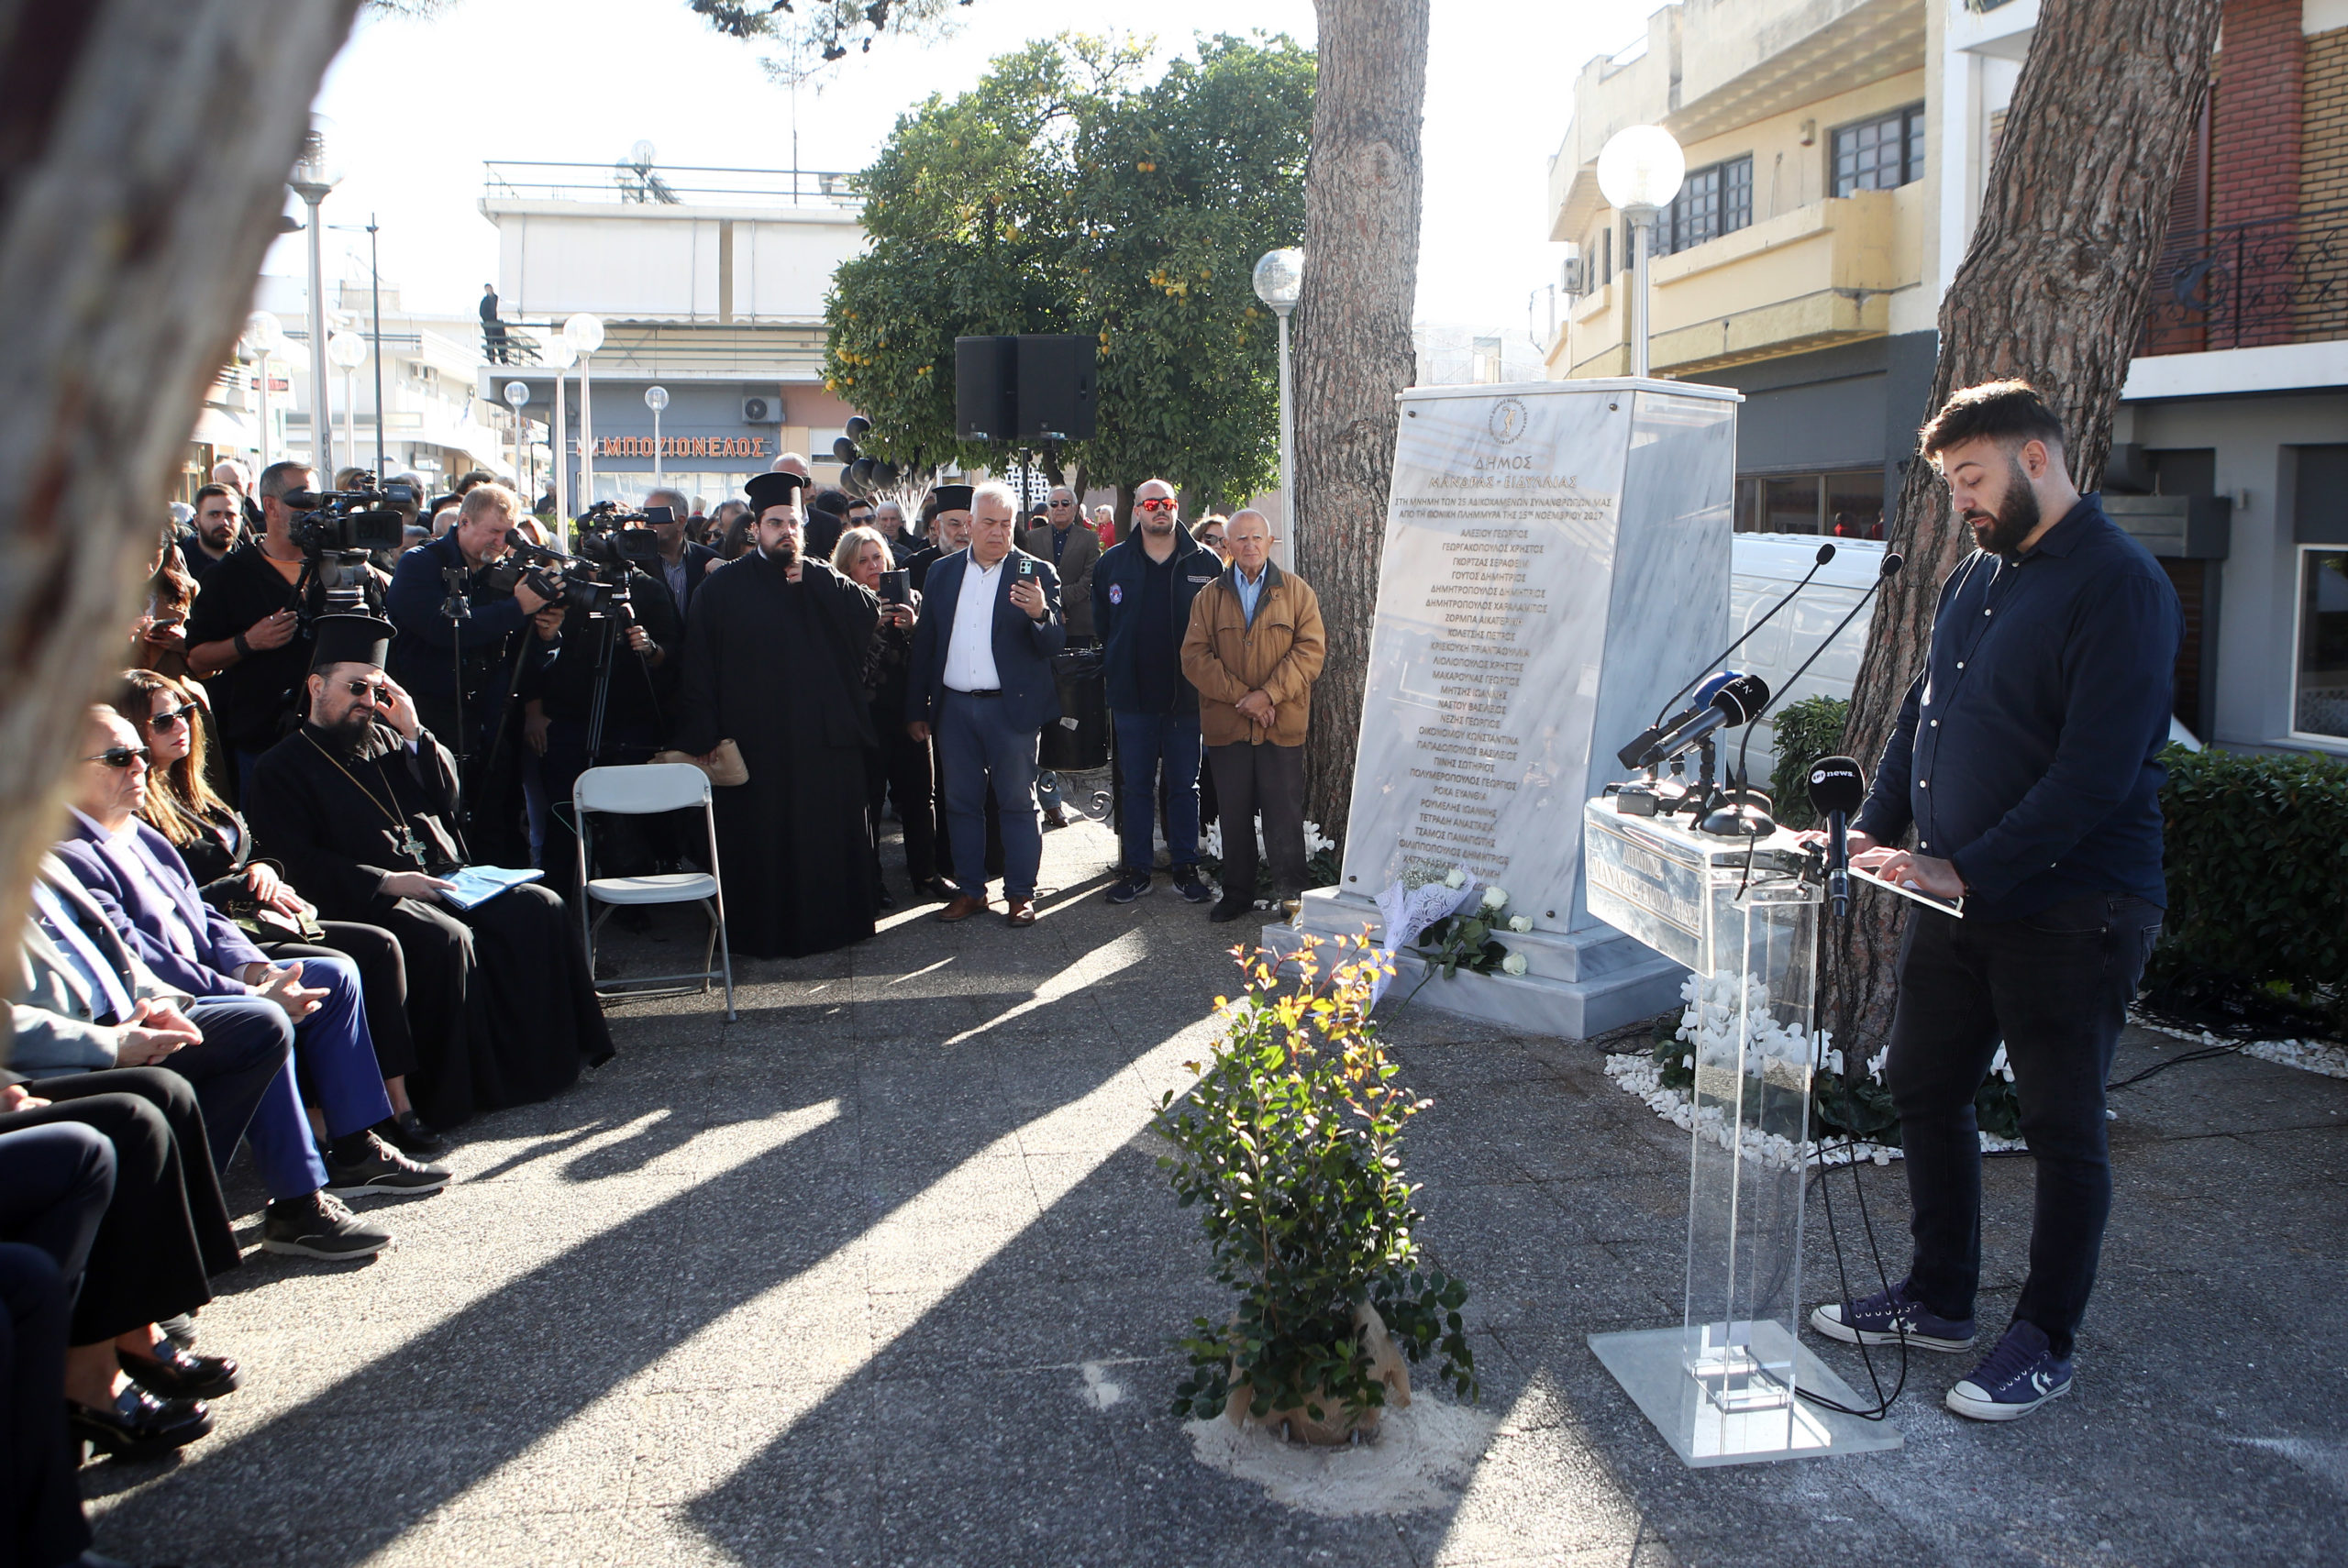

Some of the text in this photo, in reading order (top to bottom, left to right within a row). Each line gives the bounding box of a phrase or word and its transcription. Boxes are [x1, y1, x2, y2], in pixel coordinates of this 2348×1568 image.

[604, 436, 764, 458] ΜΠΟΖΙΟΝΕΛΟΣ
[1474, 456, 1533, 469] ΔΗΜΟΣ
[1428, 476, 1495, 489] ΜΑΝΔΡΑΣ
[1503, 476, 1578, 489] ΕΙΔΥΛΛΙΑΣ
[1395, 498, 1409, 506] ΣΤΗ
[1410, 498, 1440, 506] ΜΝΗΜΗ
[1441, 498, 1456, 506] ΤΩΝ
[1399, 510, 1415, 518] ΑΠΟ
[1416, 510, 1425, 519] ΤΗ
[1457, 510, 1501, 519] ΠΛΗΜΜΥΡΑ
[1510, 544, 1545, 554] ΧΡΗΣΤΟΣ
[1453, 558, 1489, 567] ΓΚΟΡΤΖΑΣ
[1452, 570, 1526, 582] ΓΟΥΤΟΣ ΔΗΜΗΤΡΙΟΣ
[1431, 585, 1498, 596] ΔΗΜΗΤΡΟΠΟΥΛΟΣ
[1425, 599, 1493, 610] ΔΗΜΗΤΡΟΠΟΥΛΟΣ
[1445, 613, 1478, 624] ΖΟΡΜΠΑ
